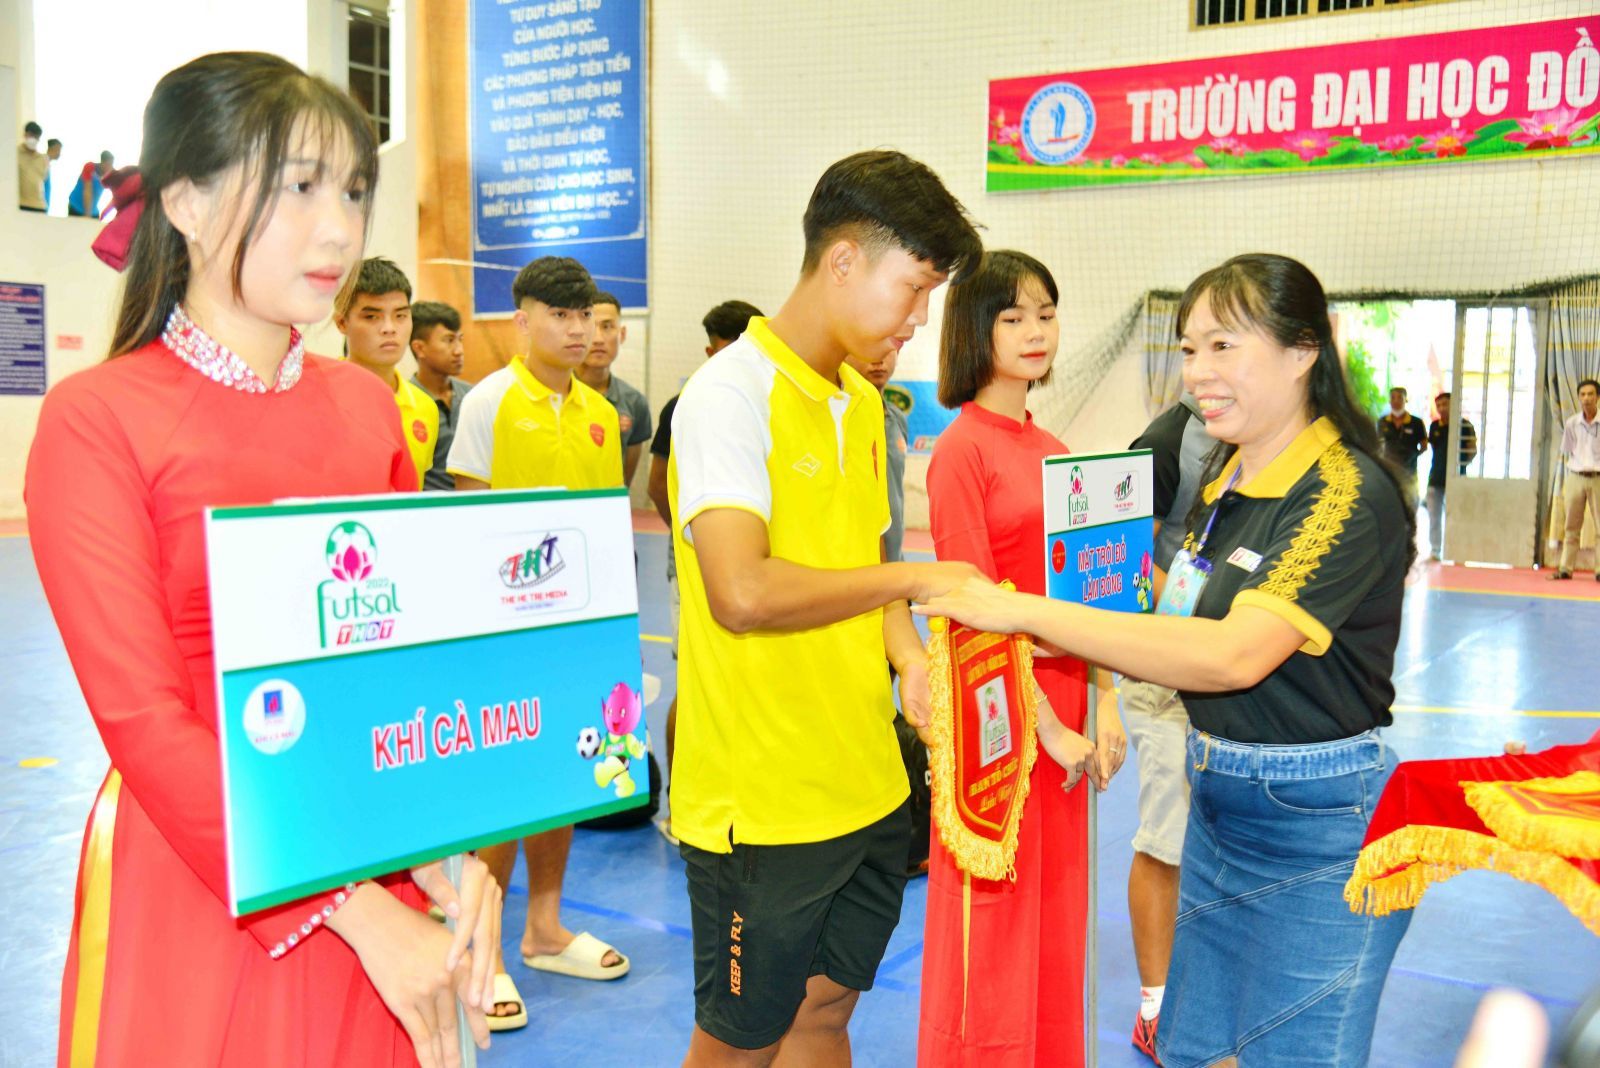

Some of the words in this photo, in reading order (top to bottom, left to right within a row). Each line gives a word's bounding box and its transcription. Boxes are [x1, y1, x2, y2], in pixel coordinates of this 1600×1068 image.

[1126, 73, 1297, 143] TRƯỜNG
[1311, 67, 1391, 136] ĐẠI
[1406, 55, 1510, 128] HỌC
[1526, 27, 1600, 111] ĐỒ
[1078, 543, 1095, 576] MẶT
[1096, 539, 1114, 569] TRỜI
[1115, 534, 1126, 564] ĐỎ
[1083, 574, 1099, 603] LÂM
[1100, 566, 1122, 599] ĐỒNG
[373, 708, 425, 770] KHÍ
[433, 700, 474, 757] CÀ
[482, 698, 540, 746] MAU
[730, 911, 744, 942] FLY
[730, 944, 742, 957] &
[730, 958, 742, 996] KEEP
